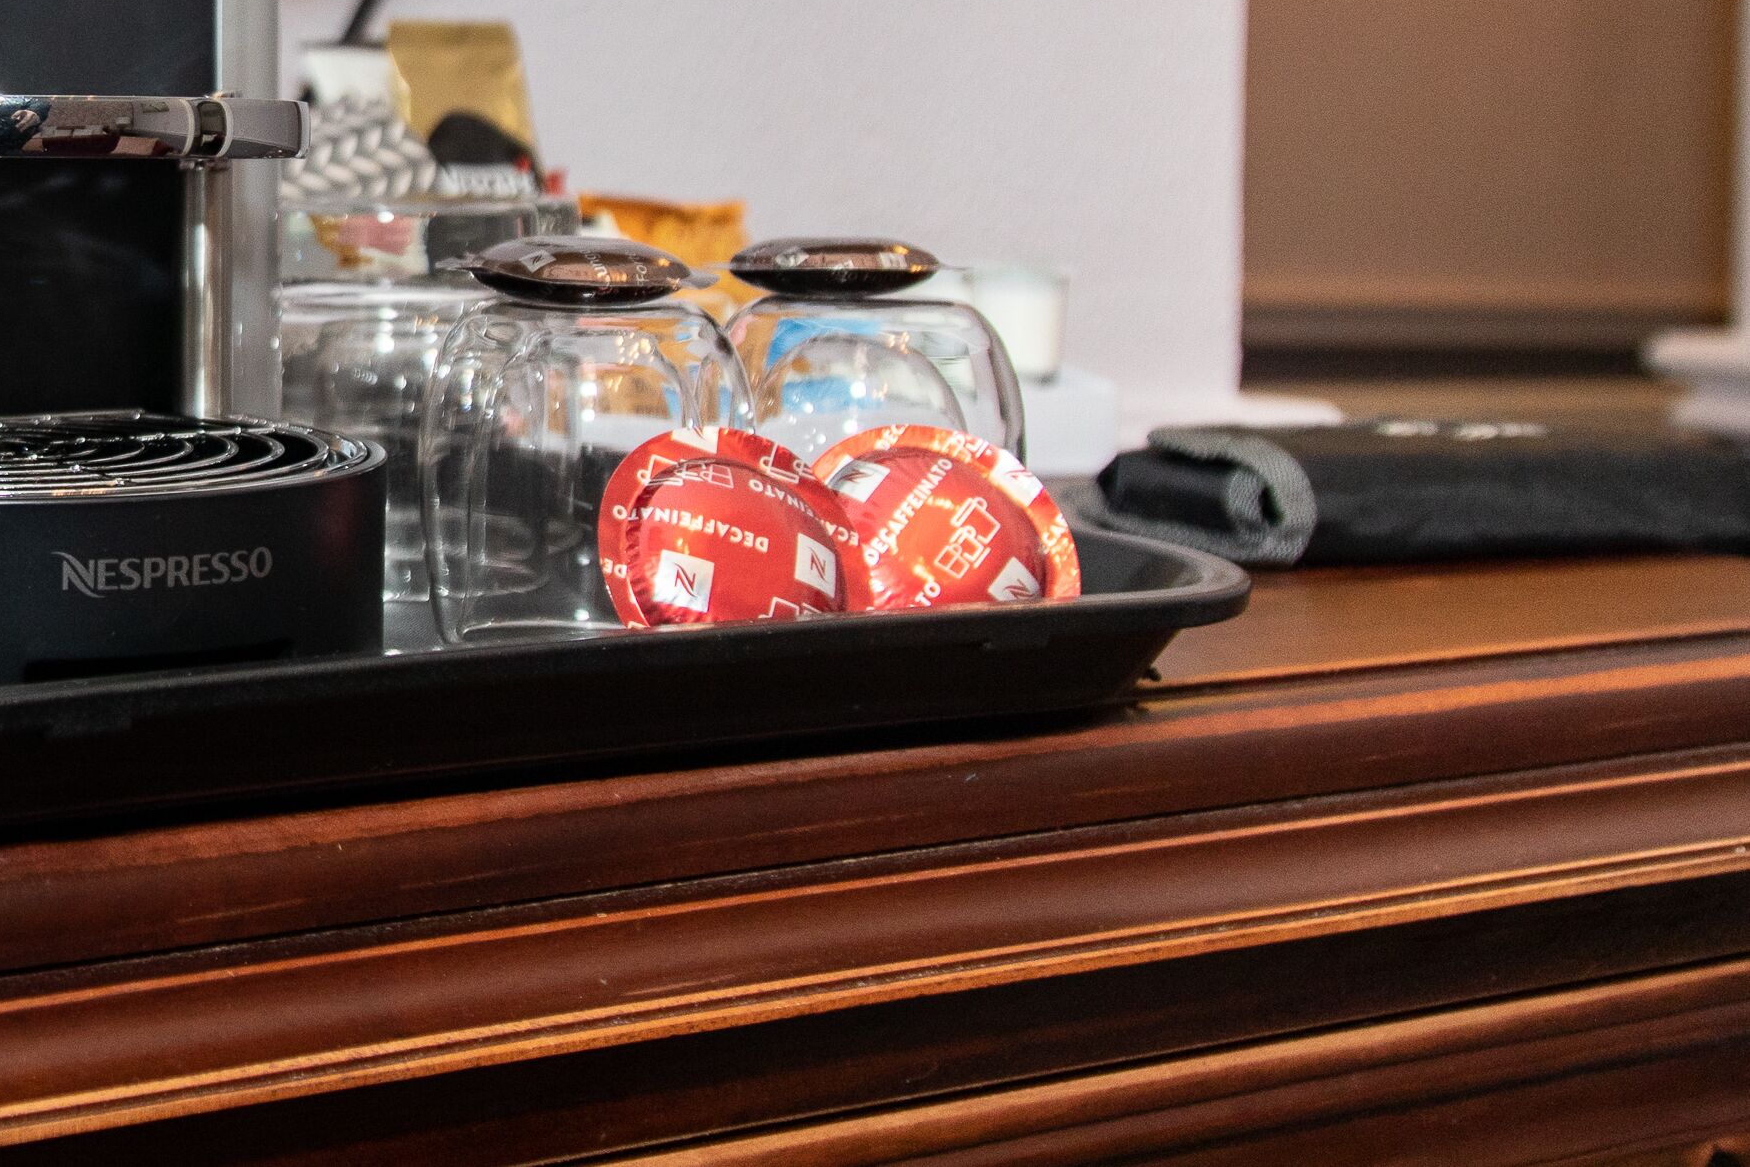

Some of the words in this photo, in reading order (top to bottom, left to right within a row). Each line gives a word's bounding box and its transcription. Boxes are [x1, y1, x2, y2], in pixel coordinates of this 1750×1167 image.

[612, 504, 770, 554] DECAFFEINATO
[862, 457, 954, 567] DECAFFEINATO
[50, 545, 274, 600] NESPRESSO
